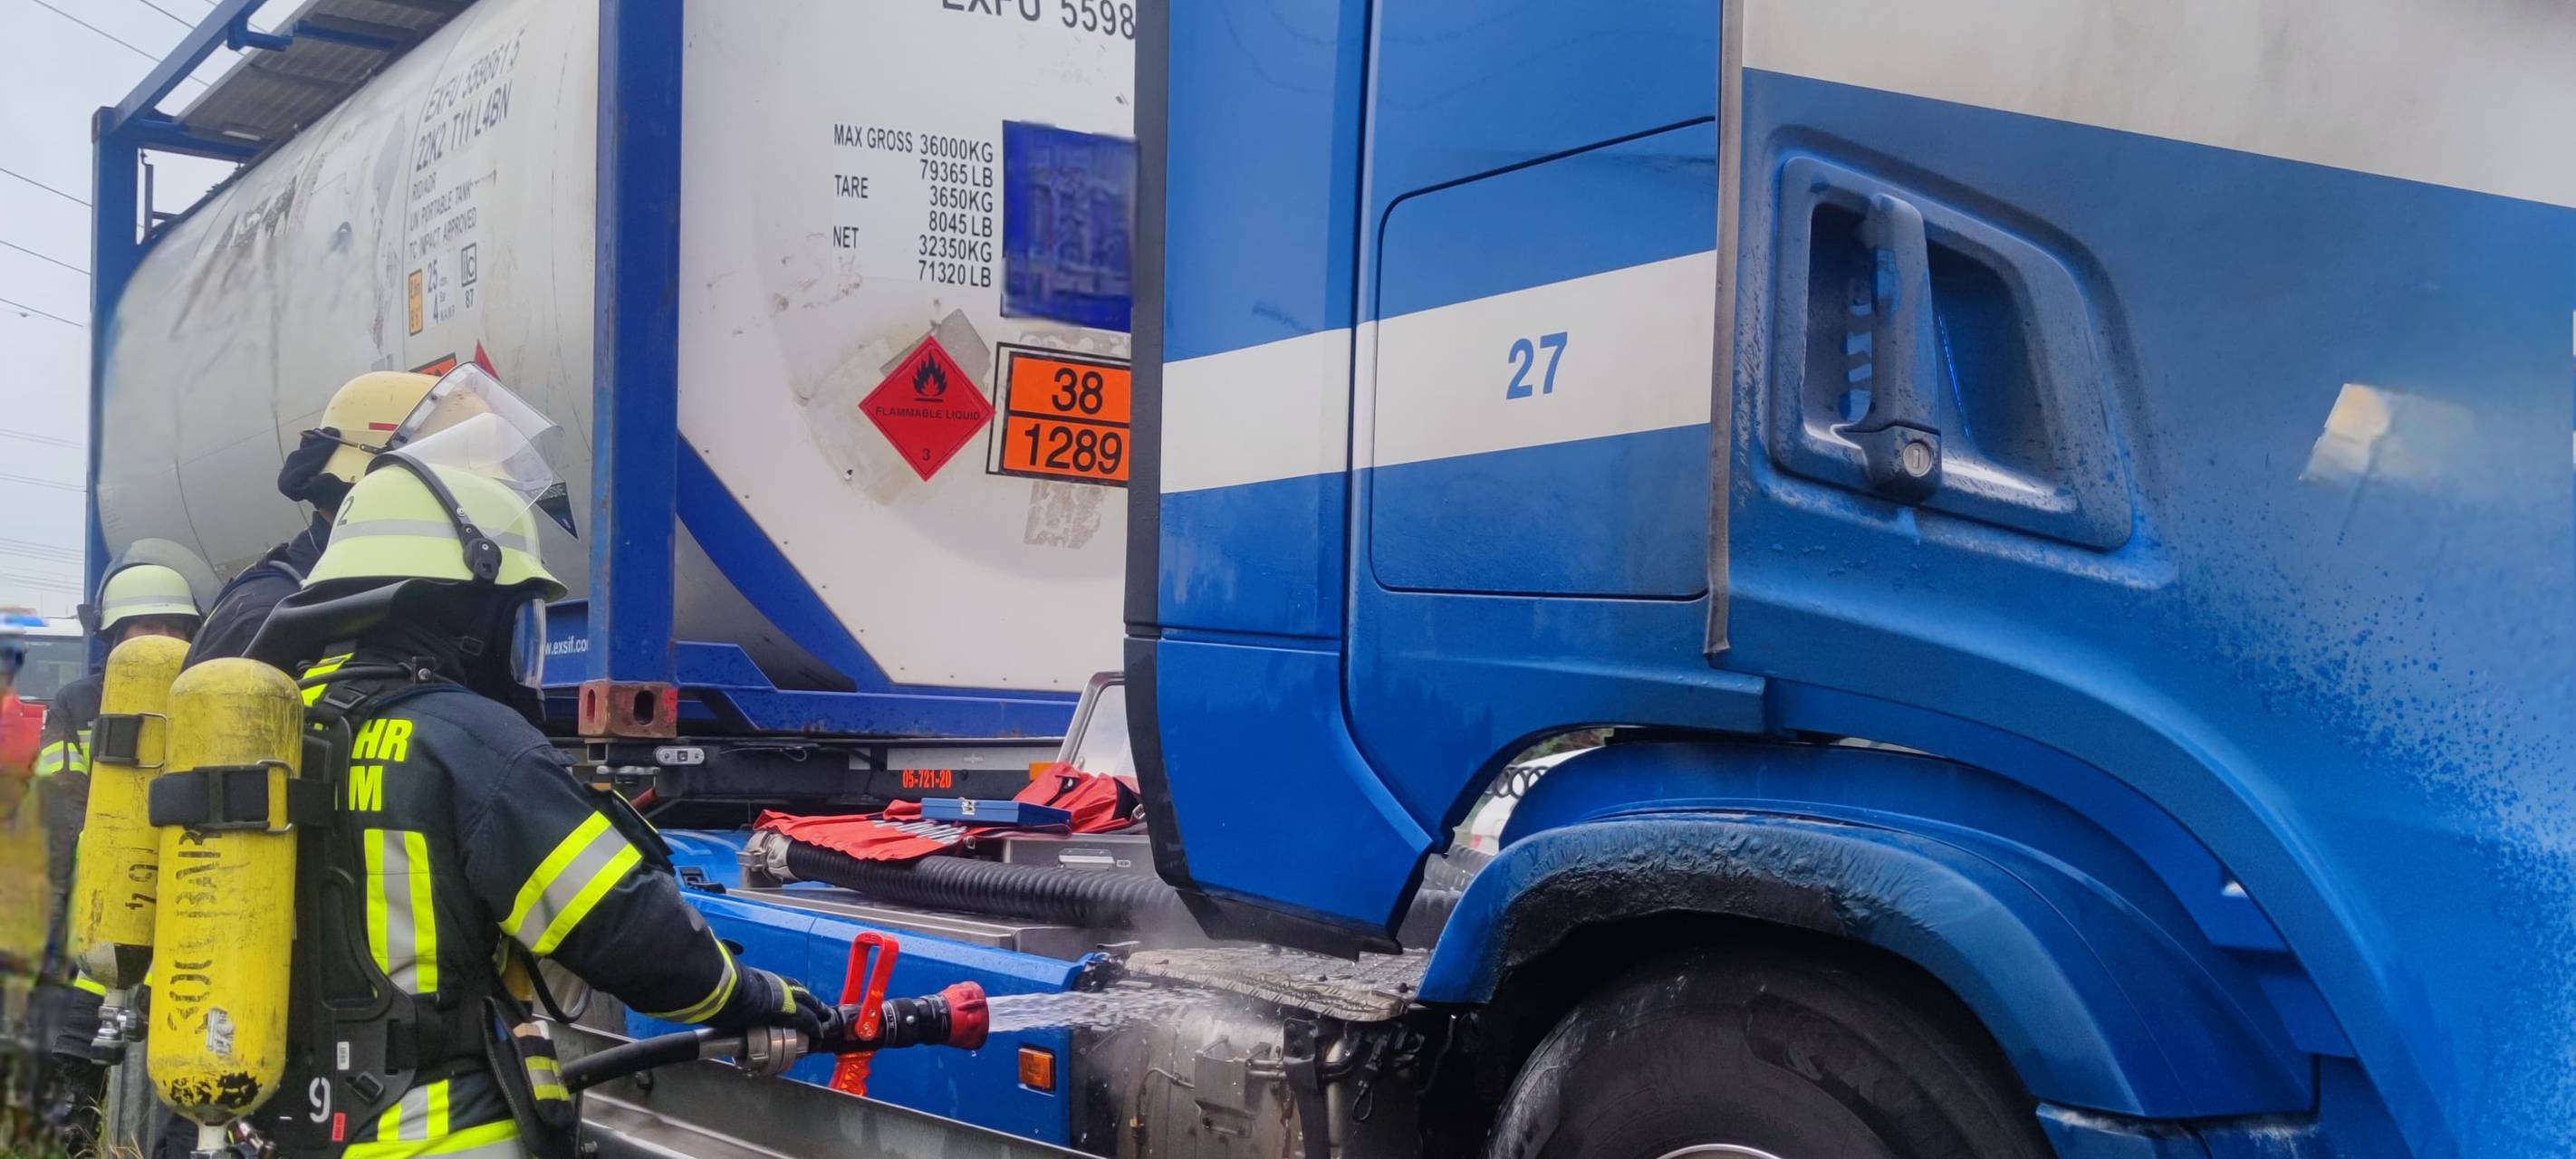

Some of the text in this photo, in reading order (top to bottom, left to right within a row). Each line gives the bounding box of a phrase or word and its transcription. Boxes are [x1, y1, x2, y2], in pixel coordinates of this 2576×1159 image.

[416, 80, 513, 172] 22K2 T11 L4BN
[834, 123, 994, 163] MAX GROSS 36000KG
[919, 159, 994, 188] 79365 LB
[422, 191, 452, 225] PORTABLE
[834, 175, 994, 213] TARE 3650KG
[929, 211, 993, 237] 8045 LB
[833, 225, 993, 263] NET 32350KG
[918, 260, 992, 288] 71320 LB
[1506, 331, 1568, 400] 27
[1052, 368, 1104, 415] 38
[876, 407, 980, 421] FLAMMABLE LIQUID
[922, 449, 931, 461] 3
[1024, 423, 1122, 474] 1289
[337, 495, 355, 526] 2
[544, 635, 589, 656] w.exsif.co
[349, 765, 383, 811] M
[902, 770, 952, 789] 05-721-20
[309, 1077, 331, 1123] 9
